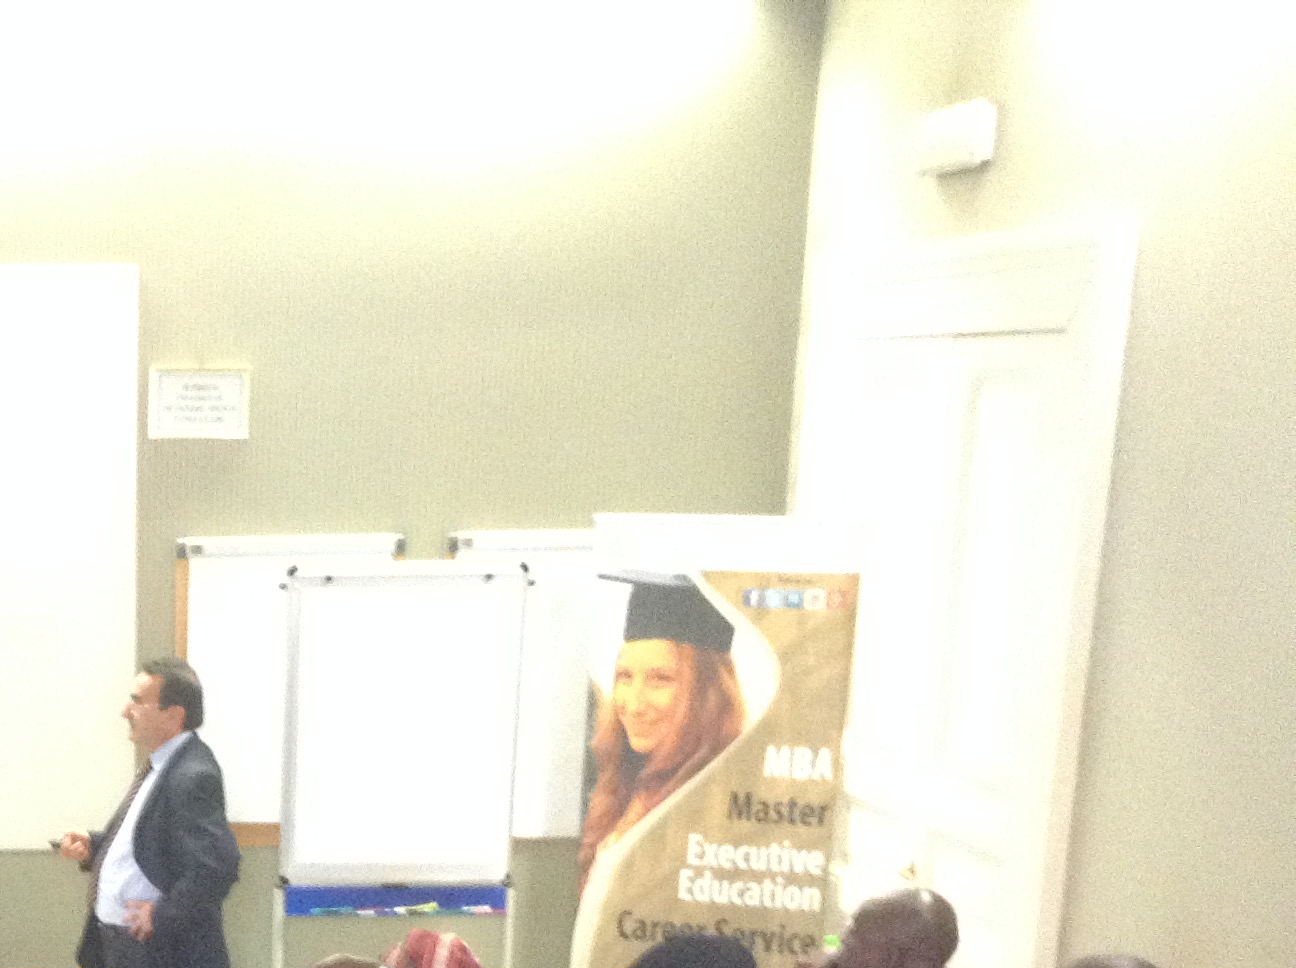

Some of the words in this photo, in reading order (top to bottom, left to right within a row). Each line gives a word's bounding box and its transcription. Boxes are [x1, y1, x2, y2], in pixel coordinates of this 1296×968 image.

[763, 744, 833, 781] MBA
[728, 791, 828, 825] Master
[687, 833, 825, 875] Executive
[678, 868, 821, 912] Education
